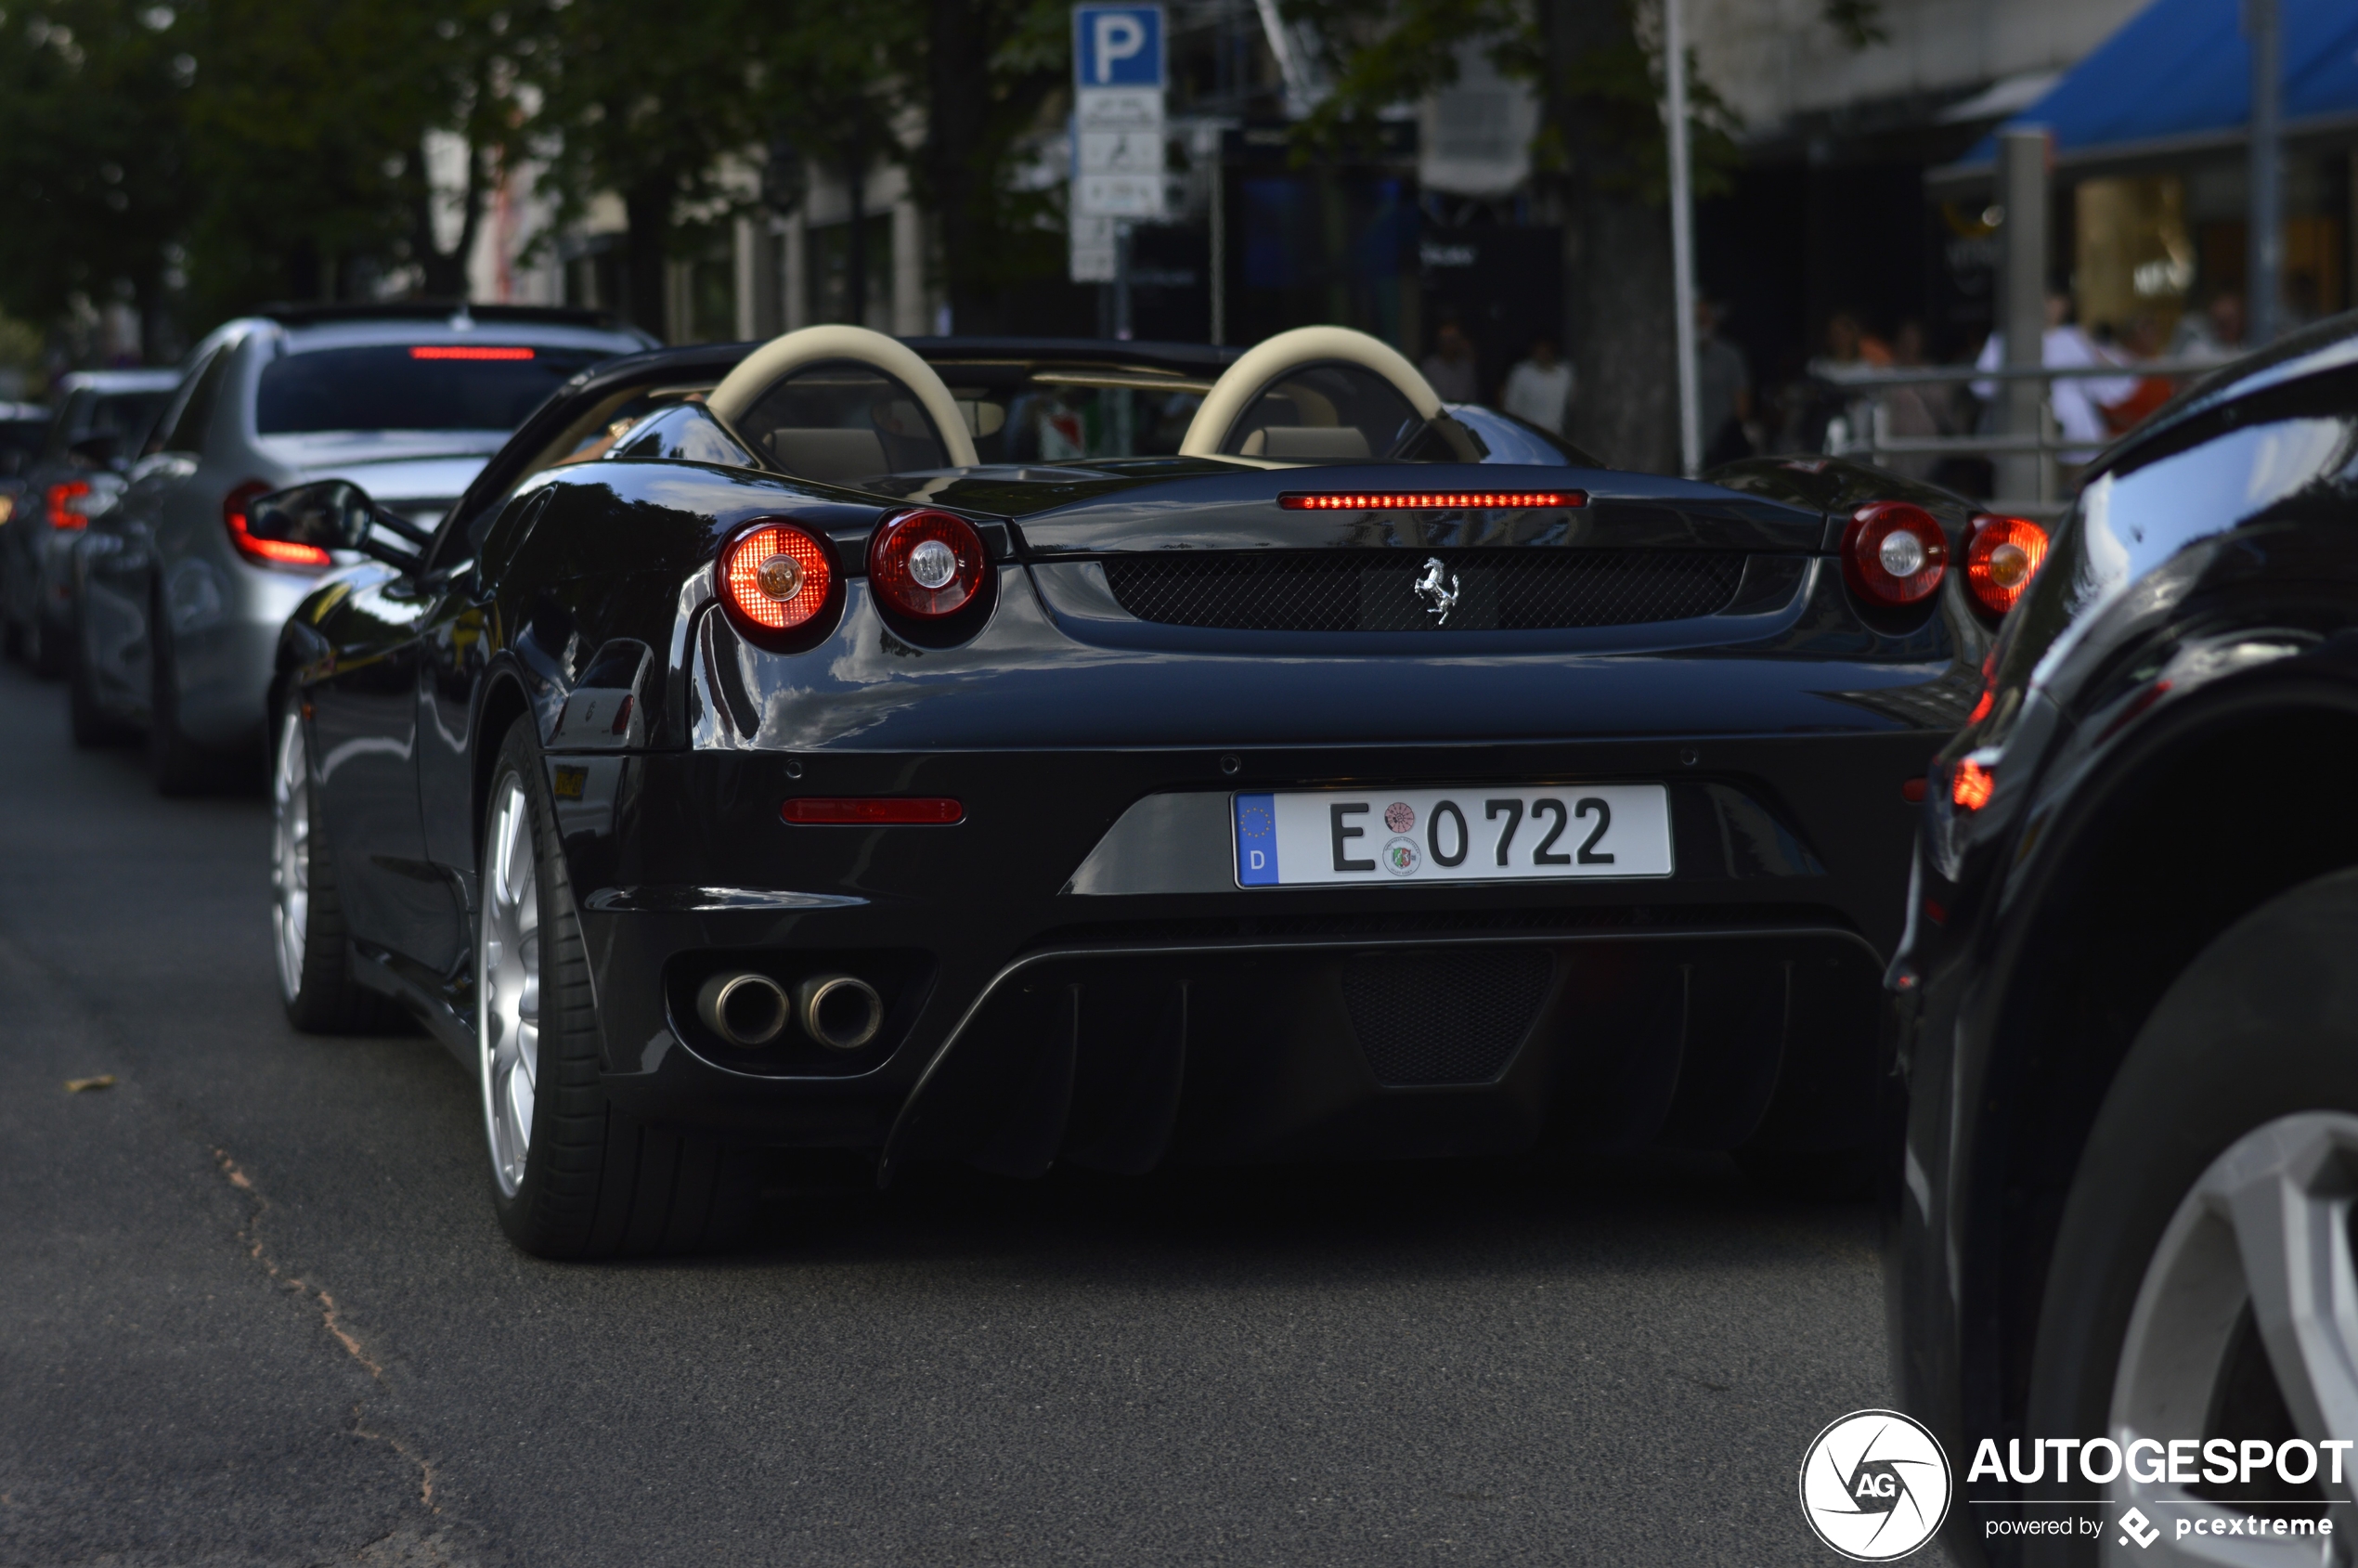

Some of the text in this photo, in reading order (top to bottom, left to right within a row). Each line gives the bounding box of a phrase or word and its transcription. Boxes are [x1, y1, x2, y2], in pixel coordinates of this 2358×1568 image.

[1095, 14, 1145, 84] P
[1249, 849, 1266, 871] D
[1328, 801, 1377, 873] E
[1484, 796, 1615, 866] 722
